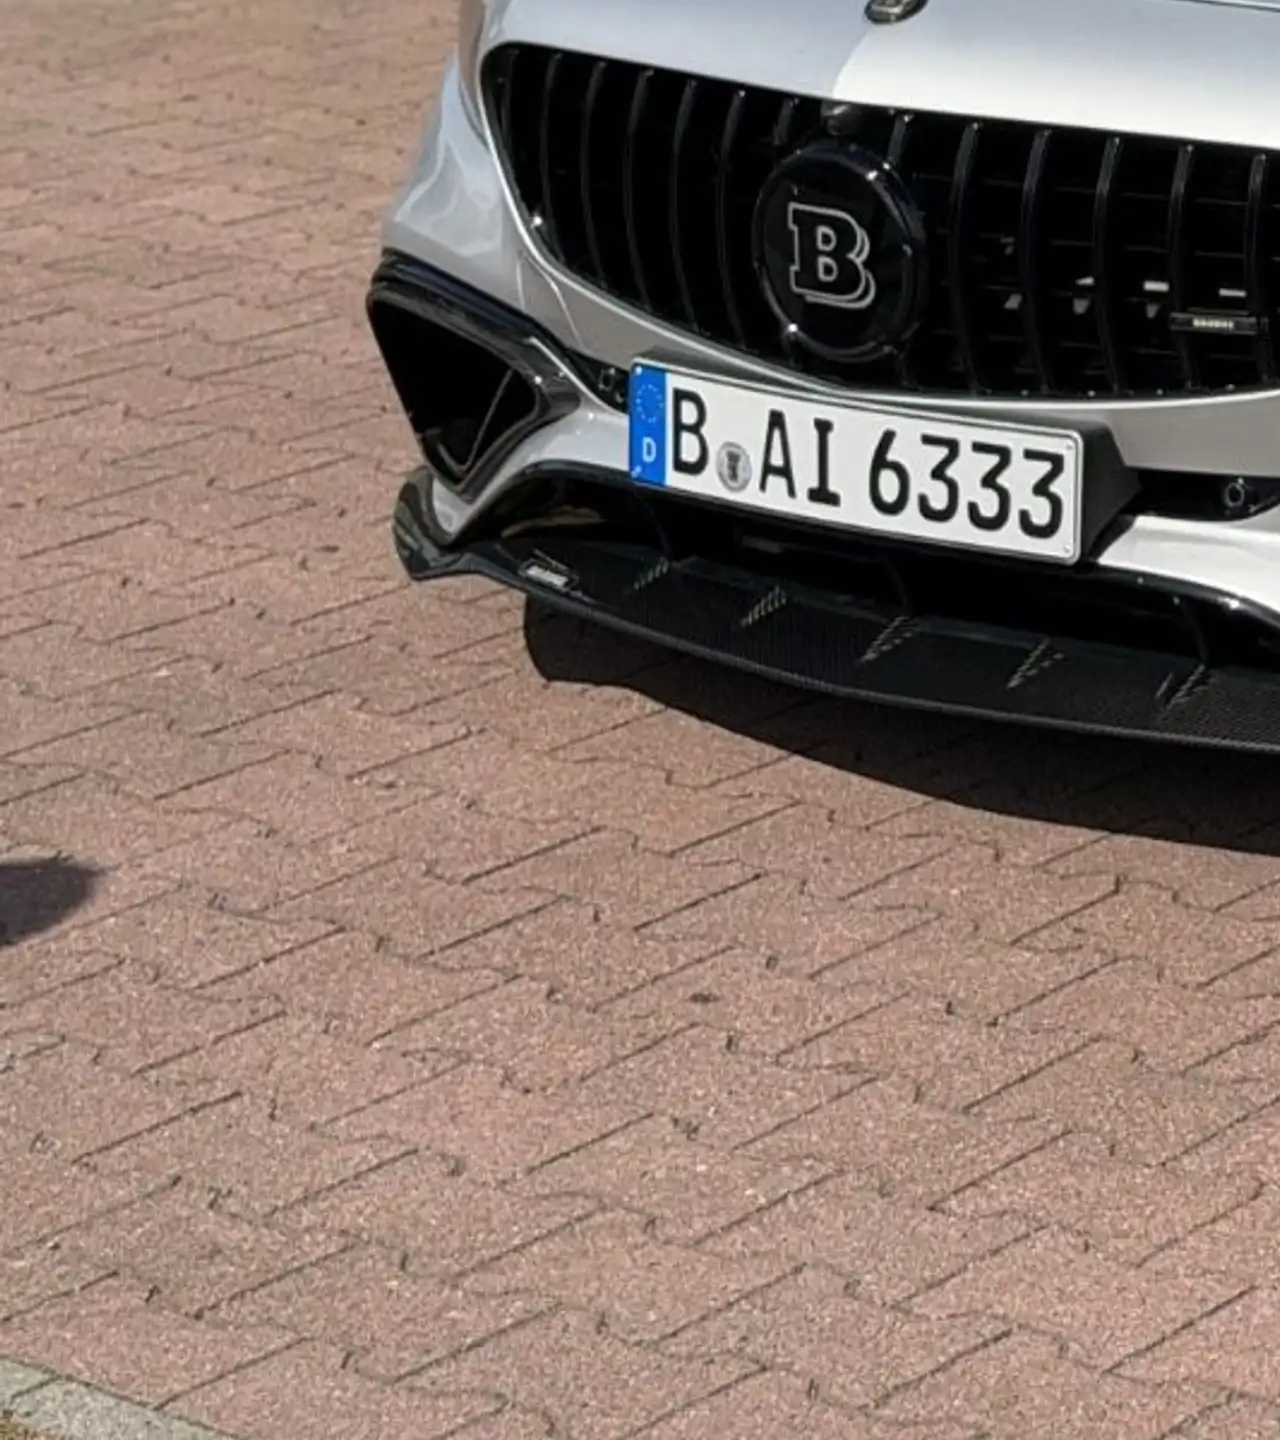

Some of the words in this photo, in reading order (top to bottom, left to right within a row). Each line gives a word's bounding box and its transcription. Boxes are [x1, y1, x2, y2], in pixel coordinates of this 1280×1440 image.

[788, 201, 876, 309] B
[642, 437, 657, 463] D
[672, 388, 709, 476] B
[759, 409, 841, 508] AI
[869, 430, 1066, 540] 6333
